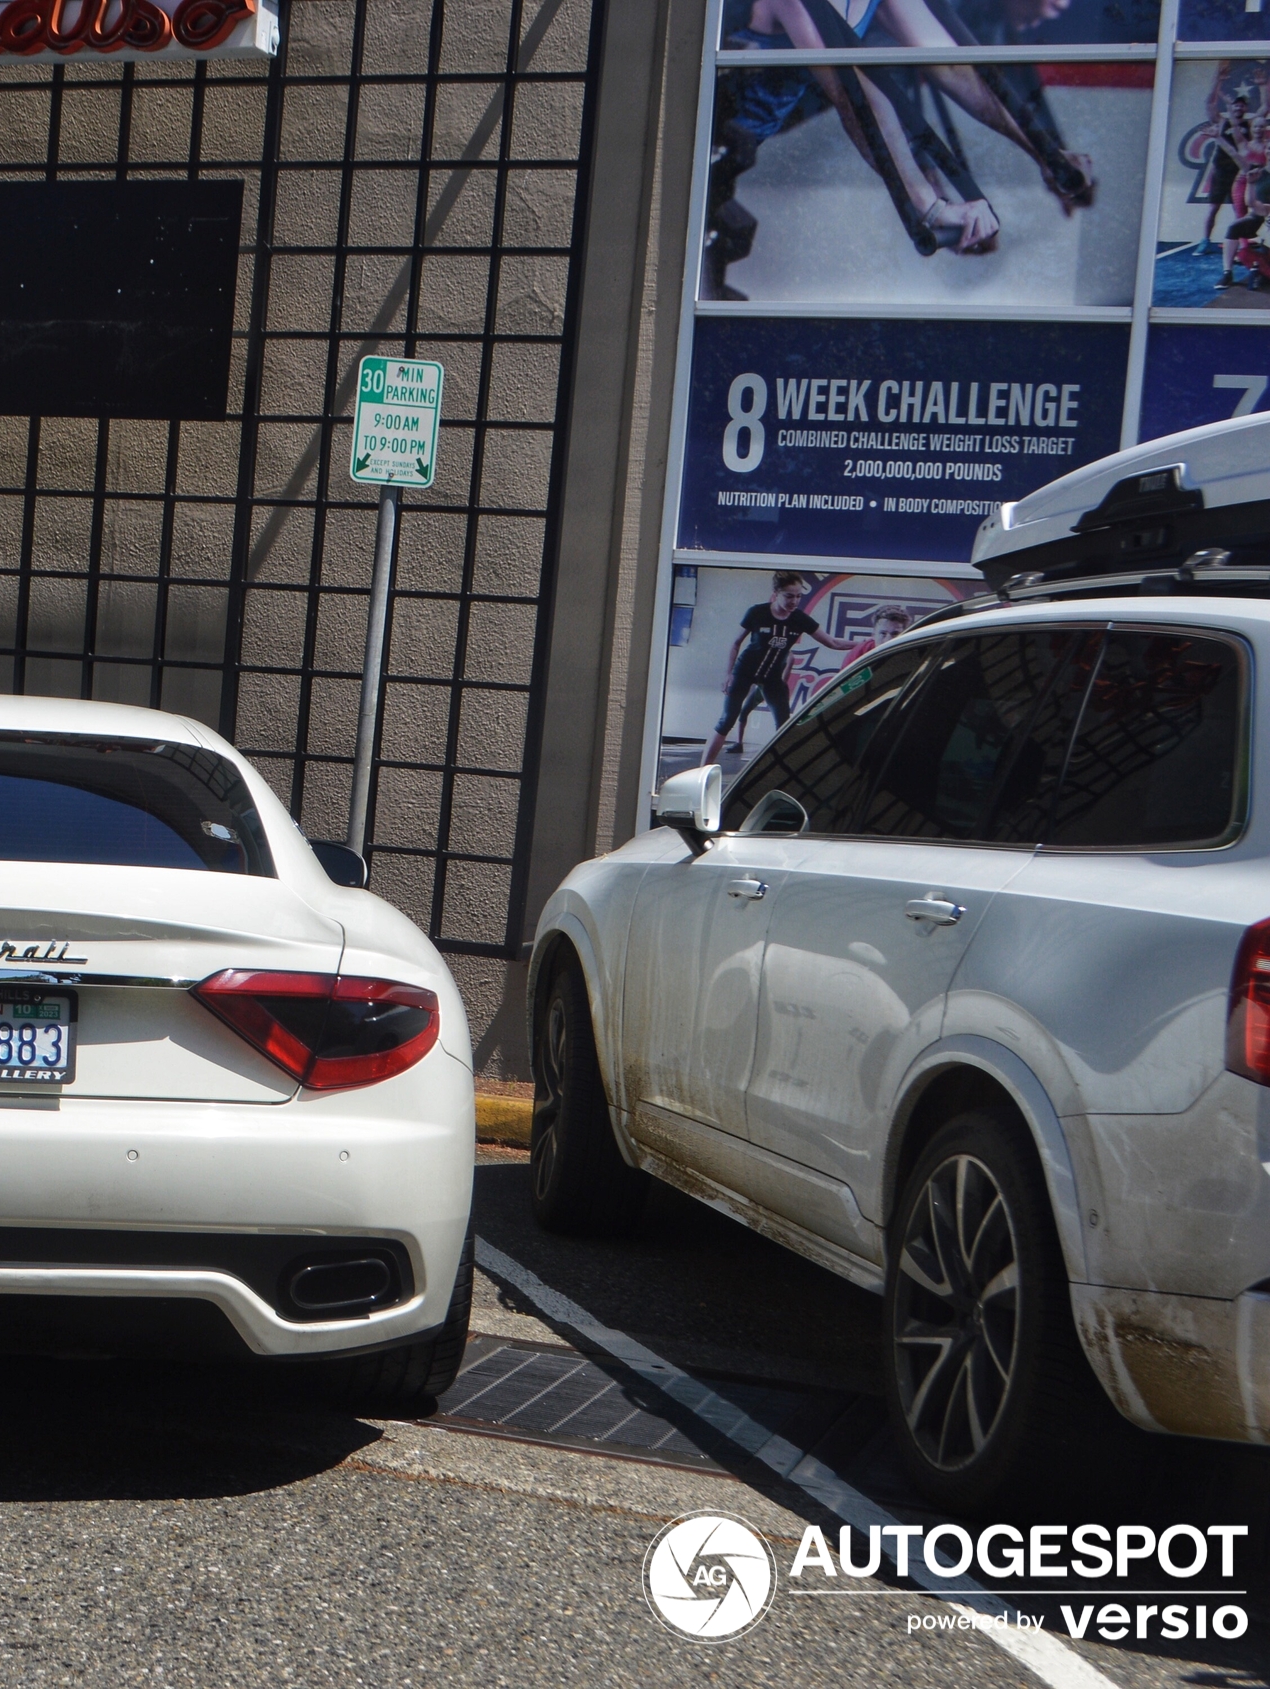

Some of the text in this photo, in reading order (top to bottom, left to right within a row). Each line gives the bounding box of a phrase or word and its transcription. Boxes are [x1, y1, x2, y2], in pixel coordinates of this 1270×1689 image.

[361, 367, 424, 393] 30 MIN
[385, 384, 435, 404] PARKING
[722, 372, 1080, 473] 8 WEEK CHALLENGE
[363, 435, 376, 451] TO
[777, 429, 1075, 455] COMBINED CHALLENGE WEIGHT LOSS TARGET
[370, 458, 415, 469] EXCEPT SUNDAYS
[843, 459, 1002, 481] 2,000,000,000 POUNDS
[717, 491, 1006, 516] NUTRITION PLAN INCLUDED IN BODY COMPOSITIO
[15, 1004, 31, 1015] 10
[38, 1010, 59, 1018] 2023
